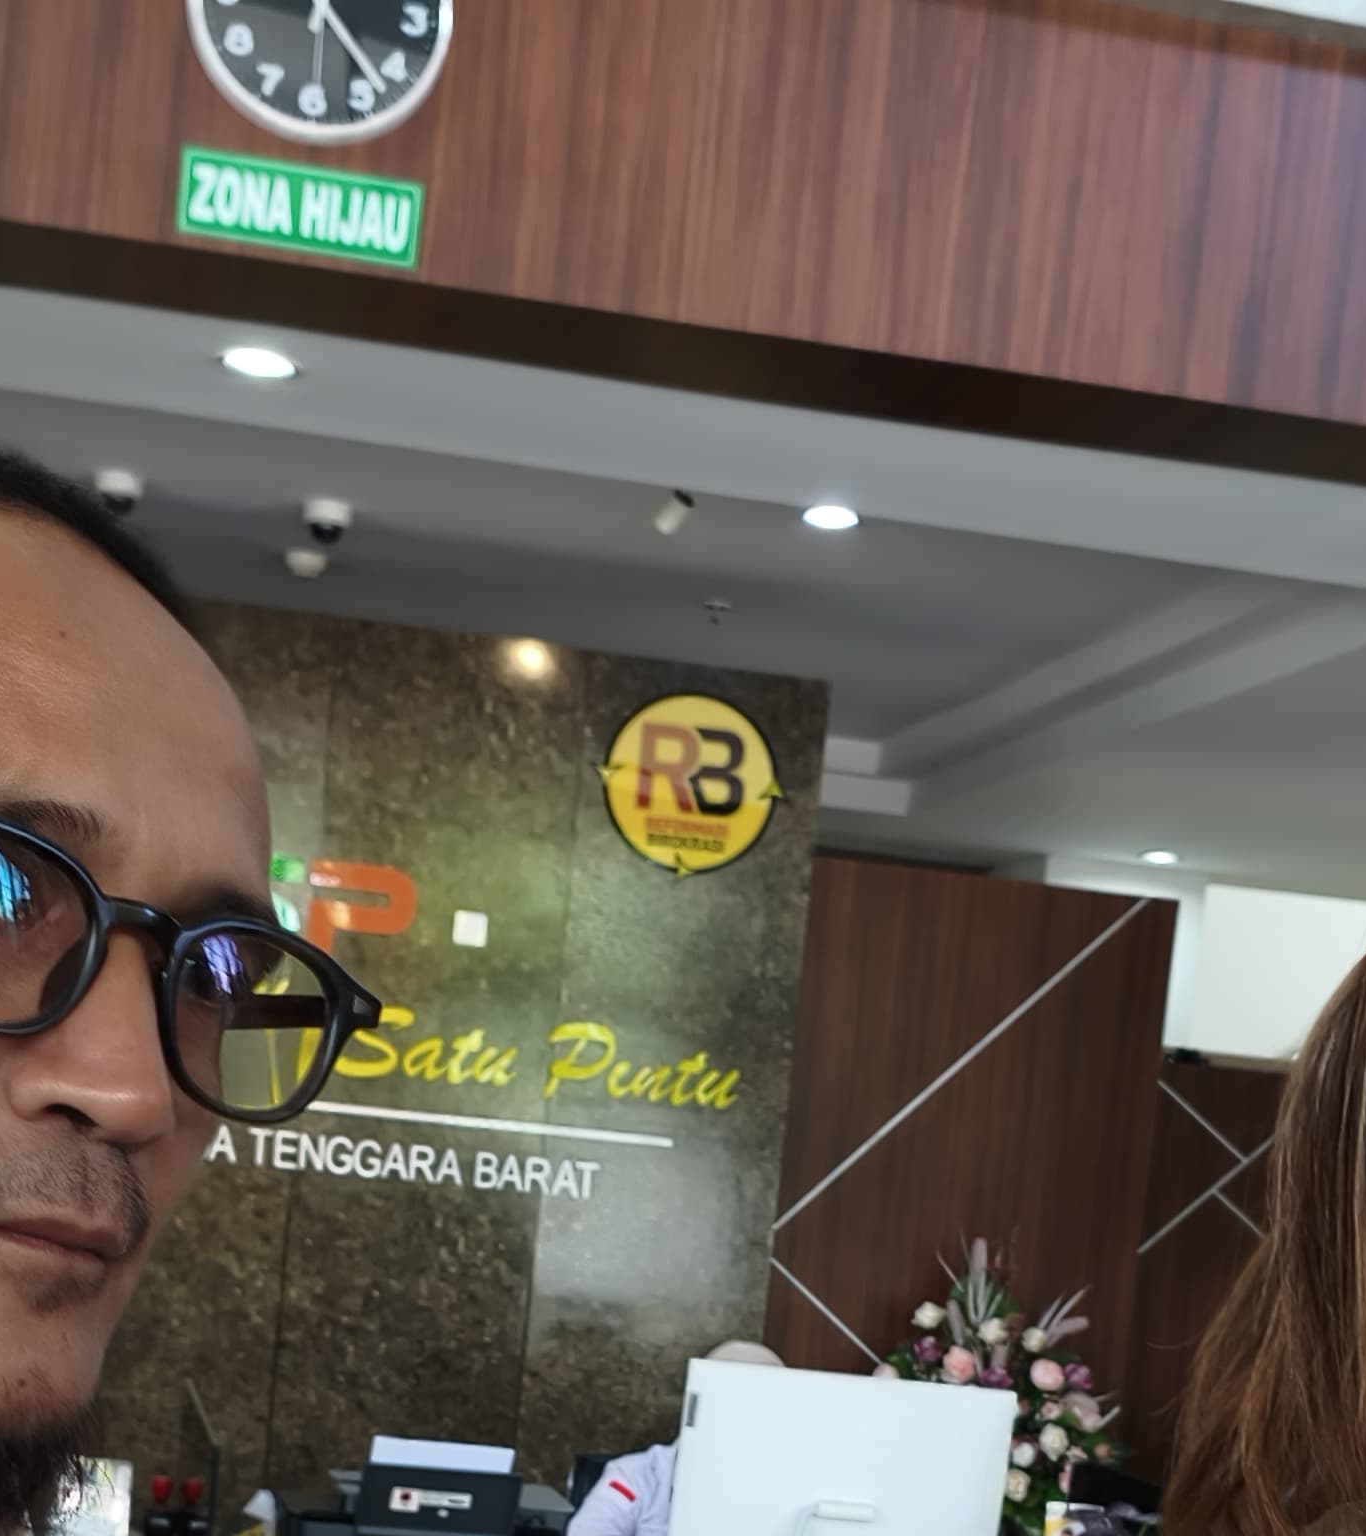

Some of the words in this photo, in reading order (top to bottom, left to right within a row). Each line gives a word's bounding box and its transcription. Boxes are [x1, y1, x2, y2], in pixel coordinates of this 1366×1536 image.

[399, 2, 430, 38] 3
[223, 22, 254, 57] 8
[256, 62, 286, 97] 7
[379, 47, 409, 83] 4
[297, 82, 328, 117] 6
[187, 161, 293, 236] ZONA
[298, 179, 413, 254] HIJAU
[636, 721, 745, 816] RB
[334, 1005, 518, 1086] Satu
[247, 1125, 463, 1186] TENGGARA
[472, 1151, 601, 1200] BARAT
